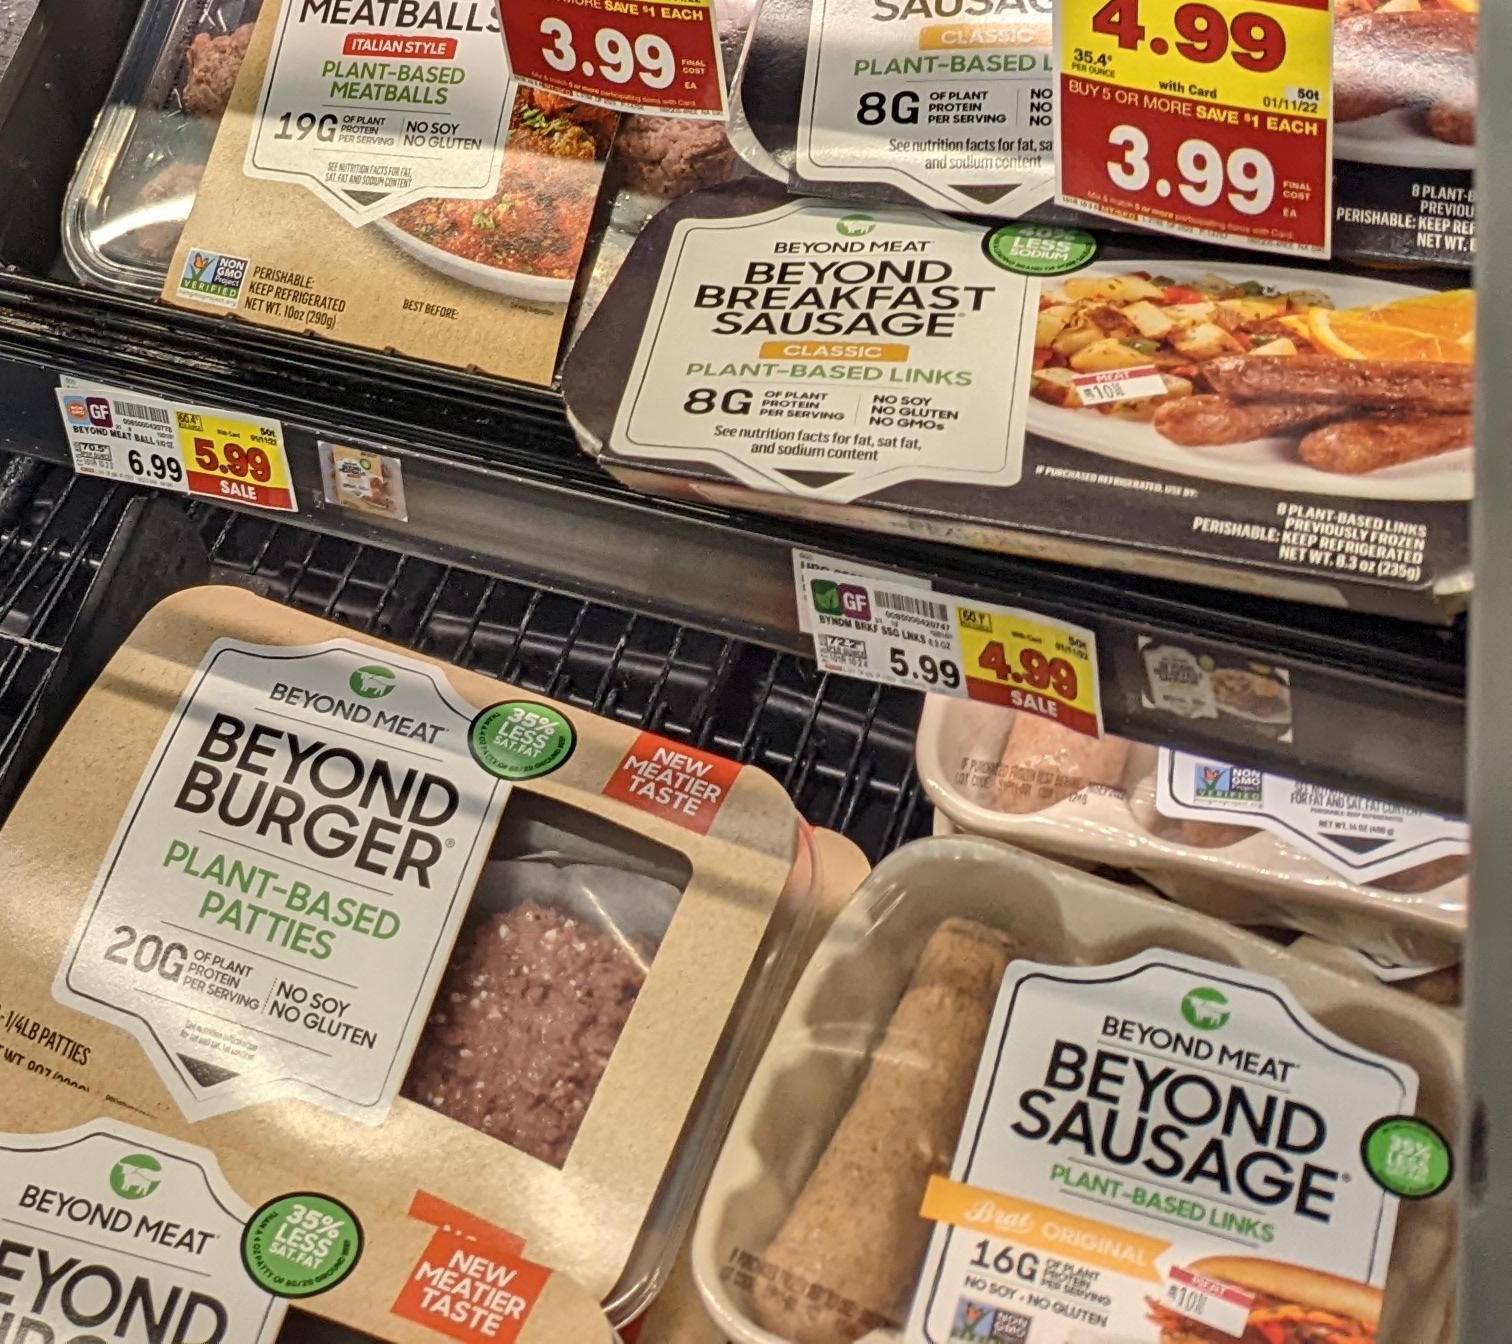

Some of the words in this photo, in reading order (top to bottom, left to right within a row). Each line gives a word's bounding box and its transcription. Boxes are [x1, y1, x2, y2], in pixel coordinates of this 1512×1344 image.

[351, 38, 402, 54] ITALIAN
[405, 40, 446, 56] STYLE
[540, 17, 675, 89] 3.99
[941, 29, 1033, 45] CLASSIC
[322, 61, 465, 85] PLANT-BASED
[854, 55, 1036, 76] PLANT-BASED
[330, 82, 448, 105] MEATBALLS
[1143, 95, 1192, 116] MORE
[1196, 105, 1238, 125] SAVE
[1267, 117, 1317, 135] EACH
[1107, 125, 1275, 215] 3.99
[774, 242, 865, 255] BEYOND
[869, 241, 929, 253] MEAT
[744, 260, 953, 285] BEYOND
[274, 284, 346, 312] REFRIGERATED
[694, 286, 996, 311] BREAKFAST
[712, 313, 957, 338] SAUSAGE
[782, 344, 883, 359] CLASSIC
[686, 362, 883, 382] PLANT-BASED
[889, 368, 973, 387] LINKS
[73, 425, 108, 437] BEYOND
[110, 429, 132, 441] MEAT
[134, 433, 155, 445] BALL
[739, 427, 794, 443] nutrition
[775, 443, 821, 458] sodium
[825, 447, 879, 462] content
[128, 449, 182, 483] 6.99
[194, 437, 271, 482] 5.99
[220, 481, 257, 500] SALE
[1193, 516, 1279, 544] PERISHABLE:
[1319, 536, 1422, 564] REFRIGERATED
[890, 647, 960, 690] 5.99
[978, 641, 1077, 701] 4.99
[270, 683, 373, 724] BEYOND
[374, 706, 449, 745] MEAT
[1010, 690, 1058, 718] SALE
[199, 713, 461, 828] BEYOND
[653, 745, 713, 777] NEW
[624, 756, 720, 804] MEATIER
[627, 775, 703, 817] TASTE
[174, 765, 443, 888] BURGER
[163, 840, 402, 941] PLANT-BASED
[197, 888, 336, 961] PATTIES
[1044, 1040, 1327, 1157] BEYOND
[1010, 1088, 1339, 1222] SAUSAGE
[19, 1184, 131, 1233] BEYOND
[137, 1216, 217, 1256] MEAT
[1049, 1164, 1207, 1222] PLANT-BASED
[1207, 1204, 1274, 1242] LINKS
[1042, 1220, 1146, 1267] ORIGINAL
